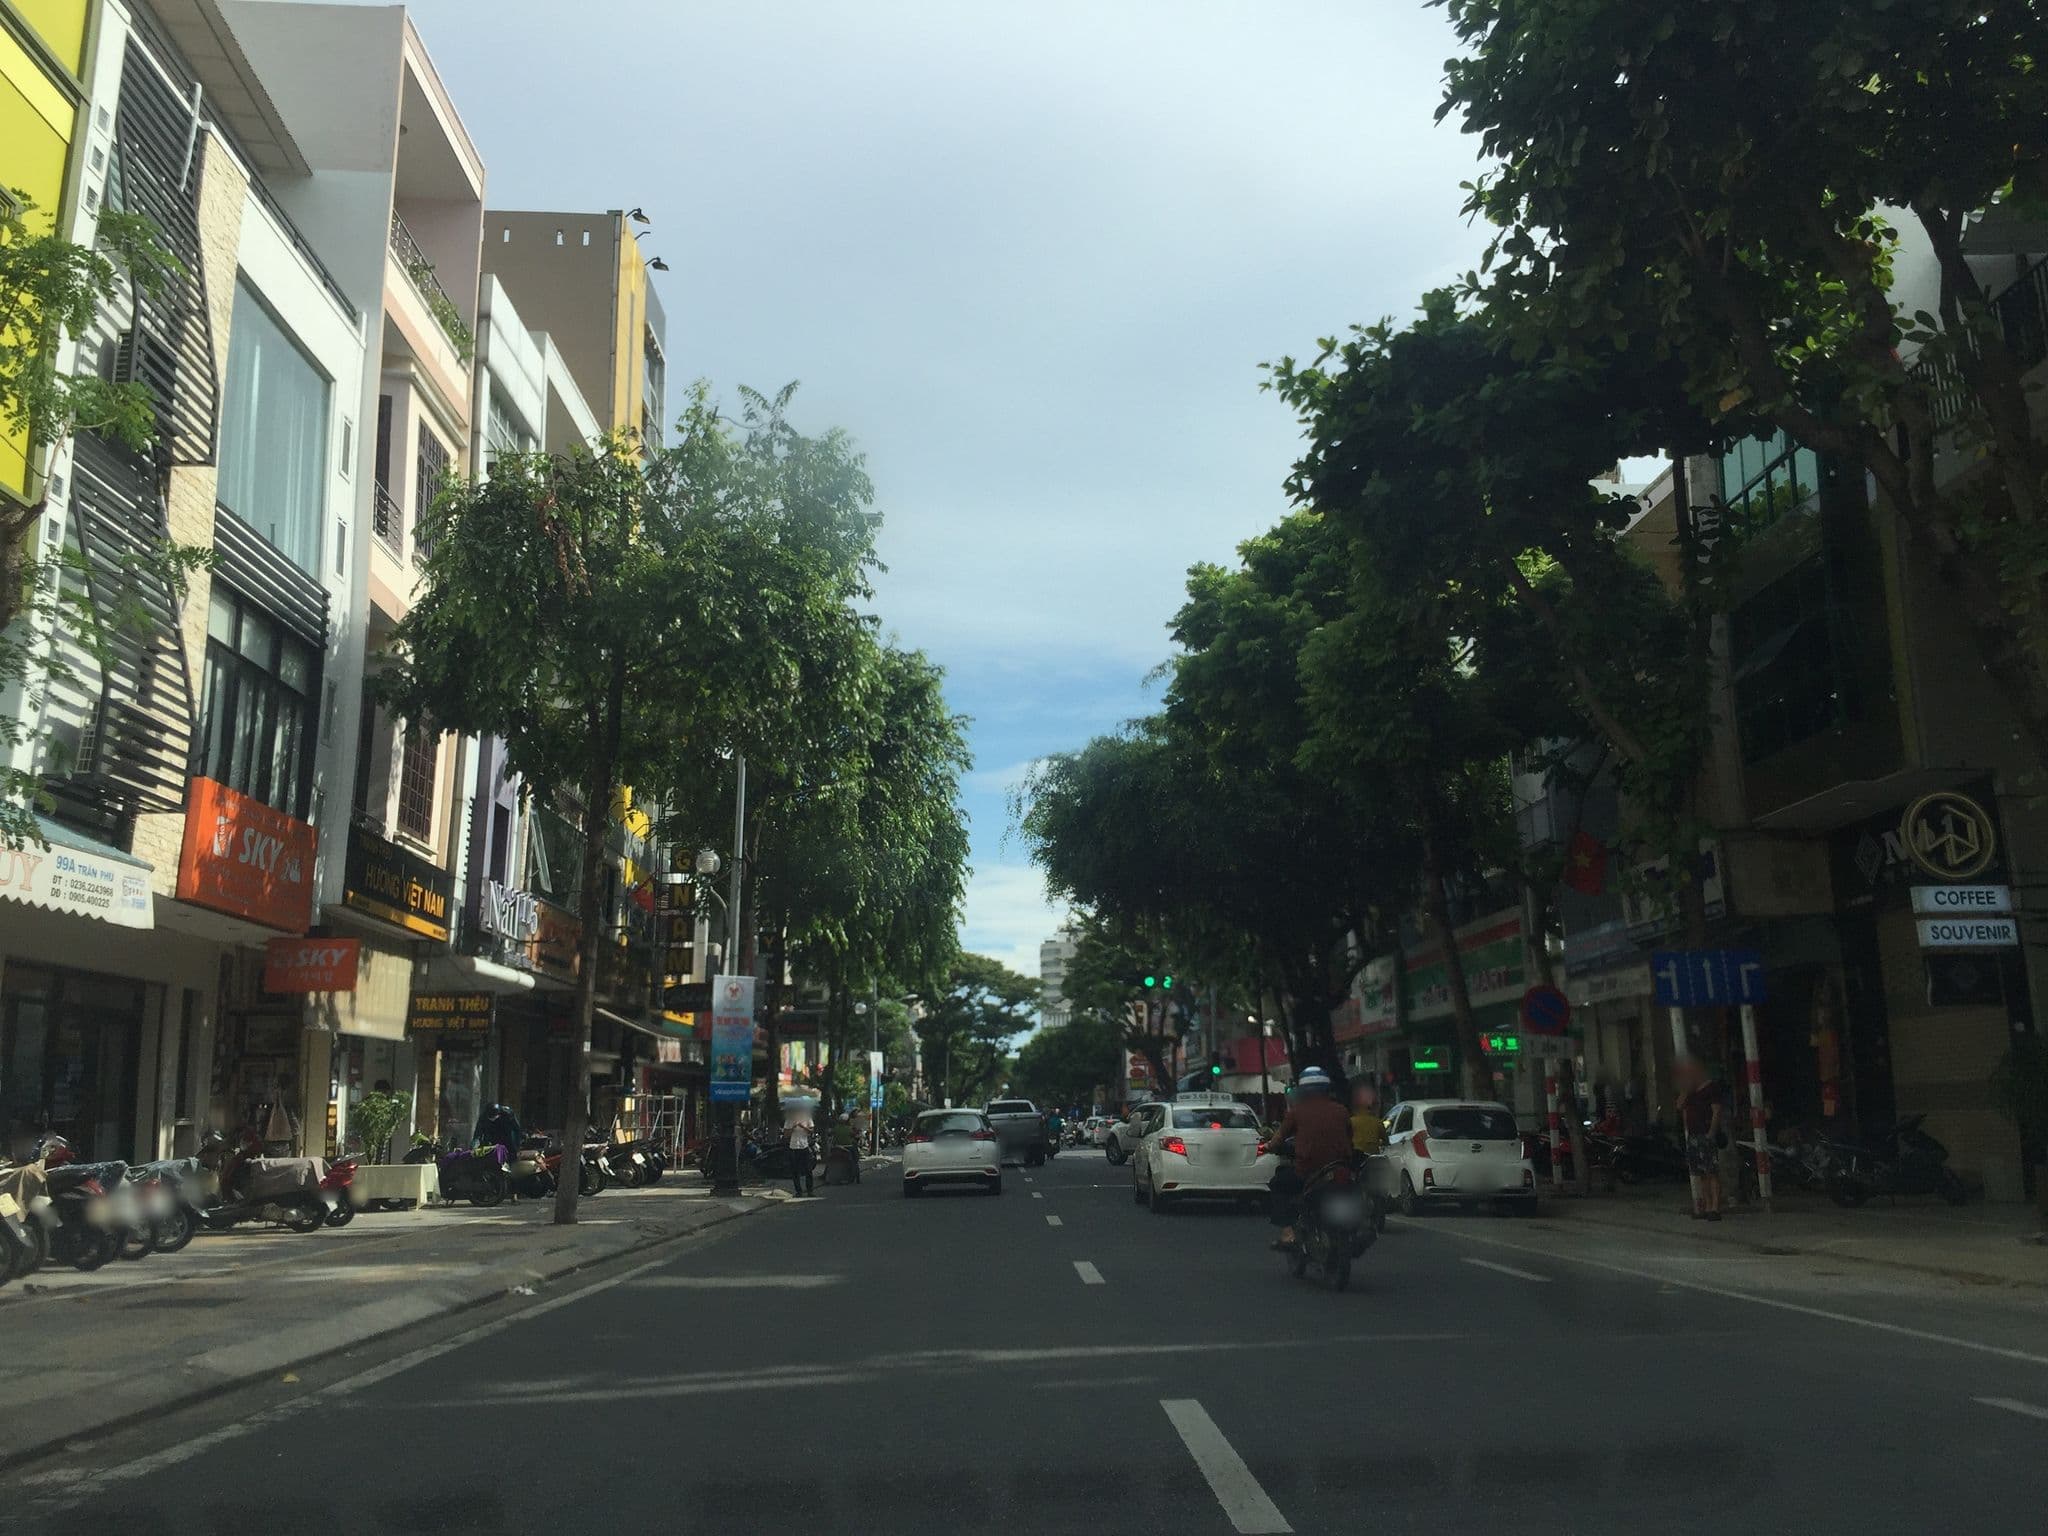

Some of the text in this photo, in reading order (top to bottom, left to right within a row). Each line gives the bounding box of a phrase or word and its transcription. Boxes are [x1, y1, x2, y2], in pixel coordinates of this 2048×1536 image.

[239, 827, 284, 873] SKY
[424, 887, 446, 919] NAM
[1934, 891, 1996, 905] COFFEE
[1931, 925, 2011, 940] SOUVENIR
[296, 948, 348, 967] SKY
